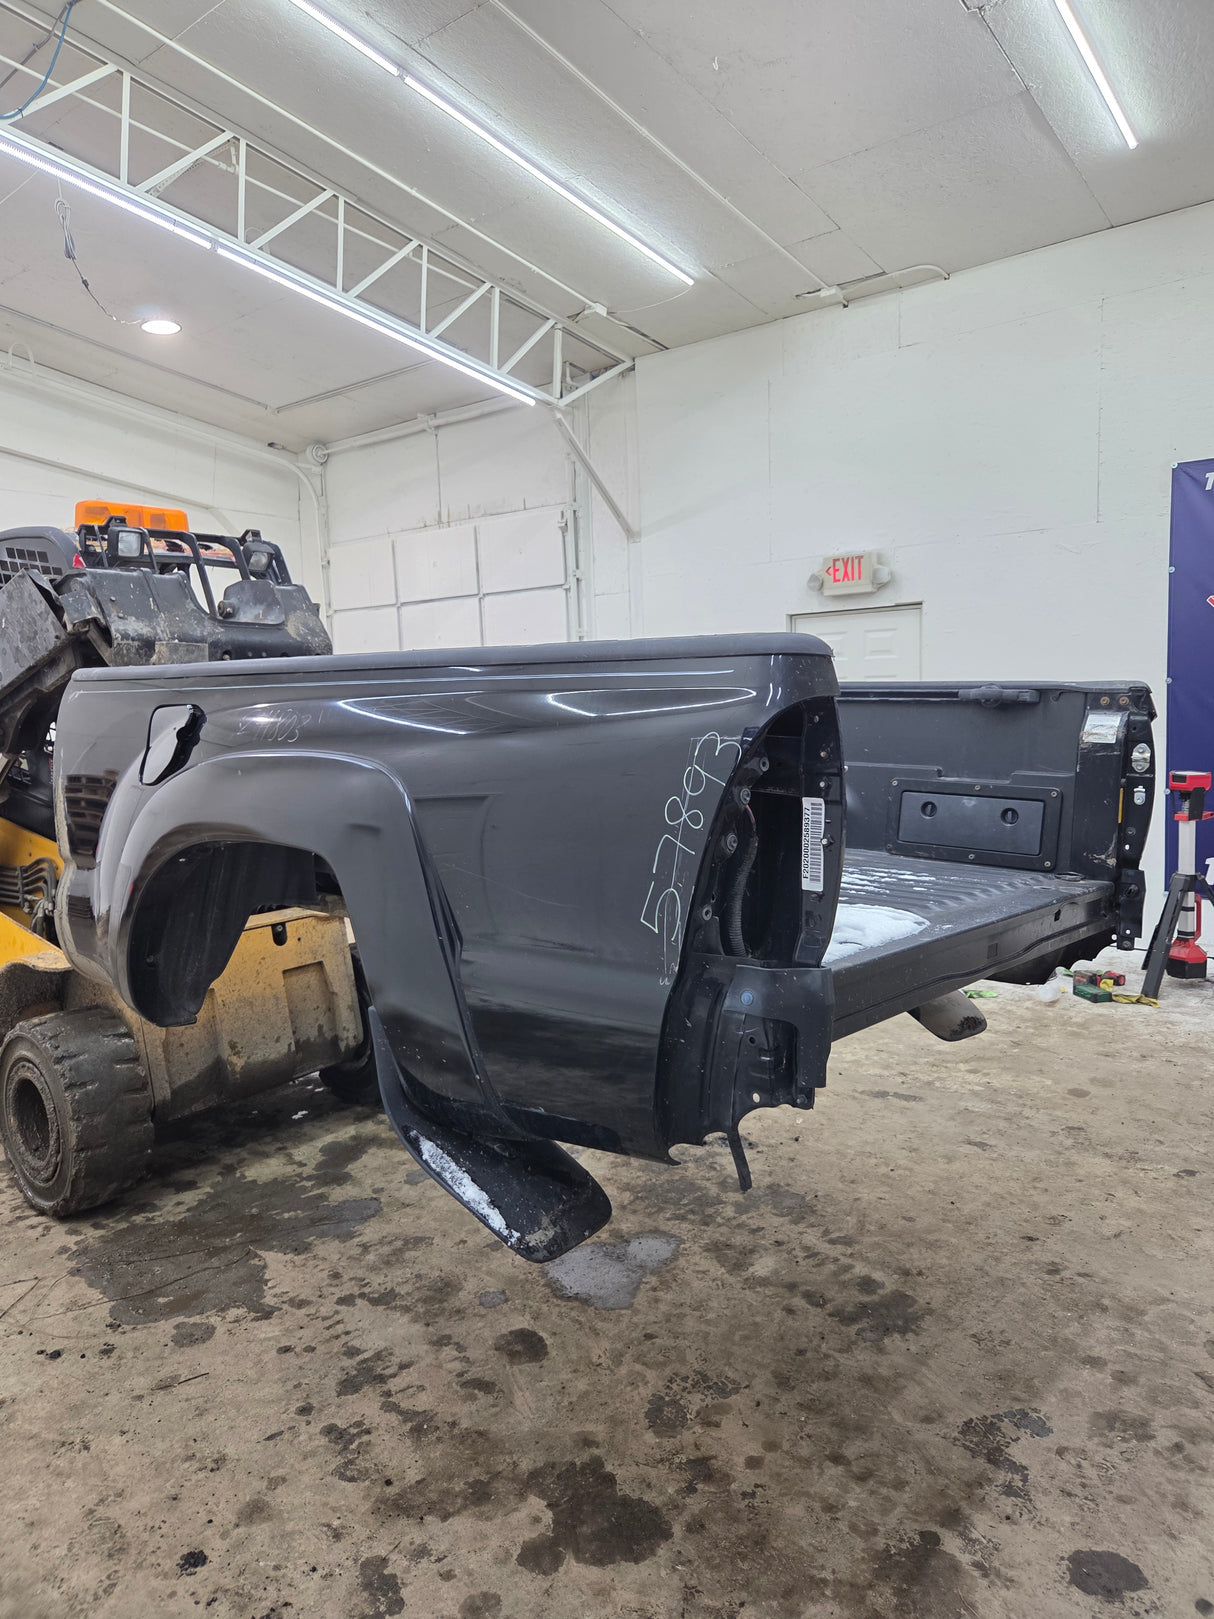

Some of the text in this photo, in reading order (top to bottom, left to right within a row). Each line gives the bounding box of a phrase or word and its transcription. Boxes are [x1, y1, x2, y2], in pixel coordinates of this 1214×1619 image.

[832, 555, 864, 583] EXIT
[640, 731, 742, 941] 57893
[802, 807, 810, 879] F2020002589377
